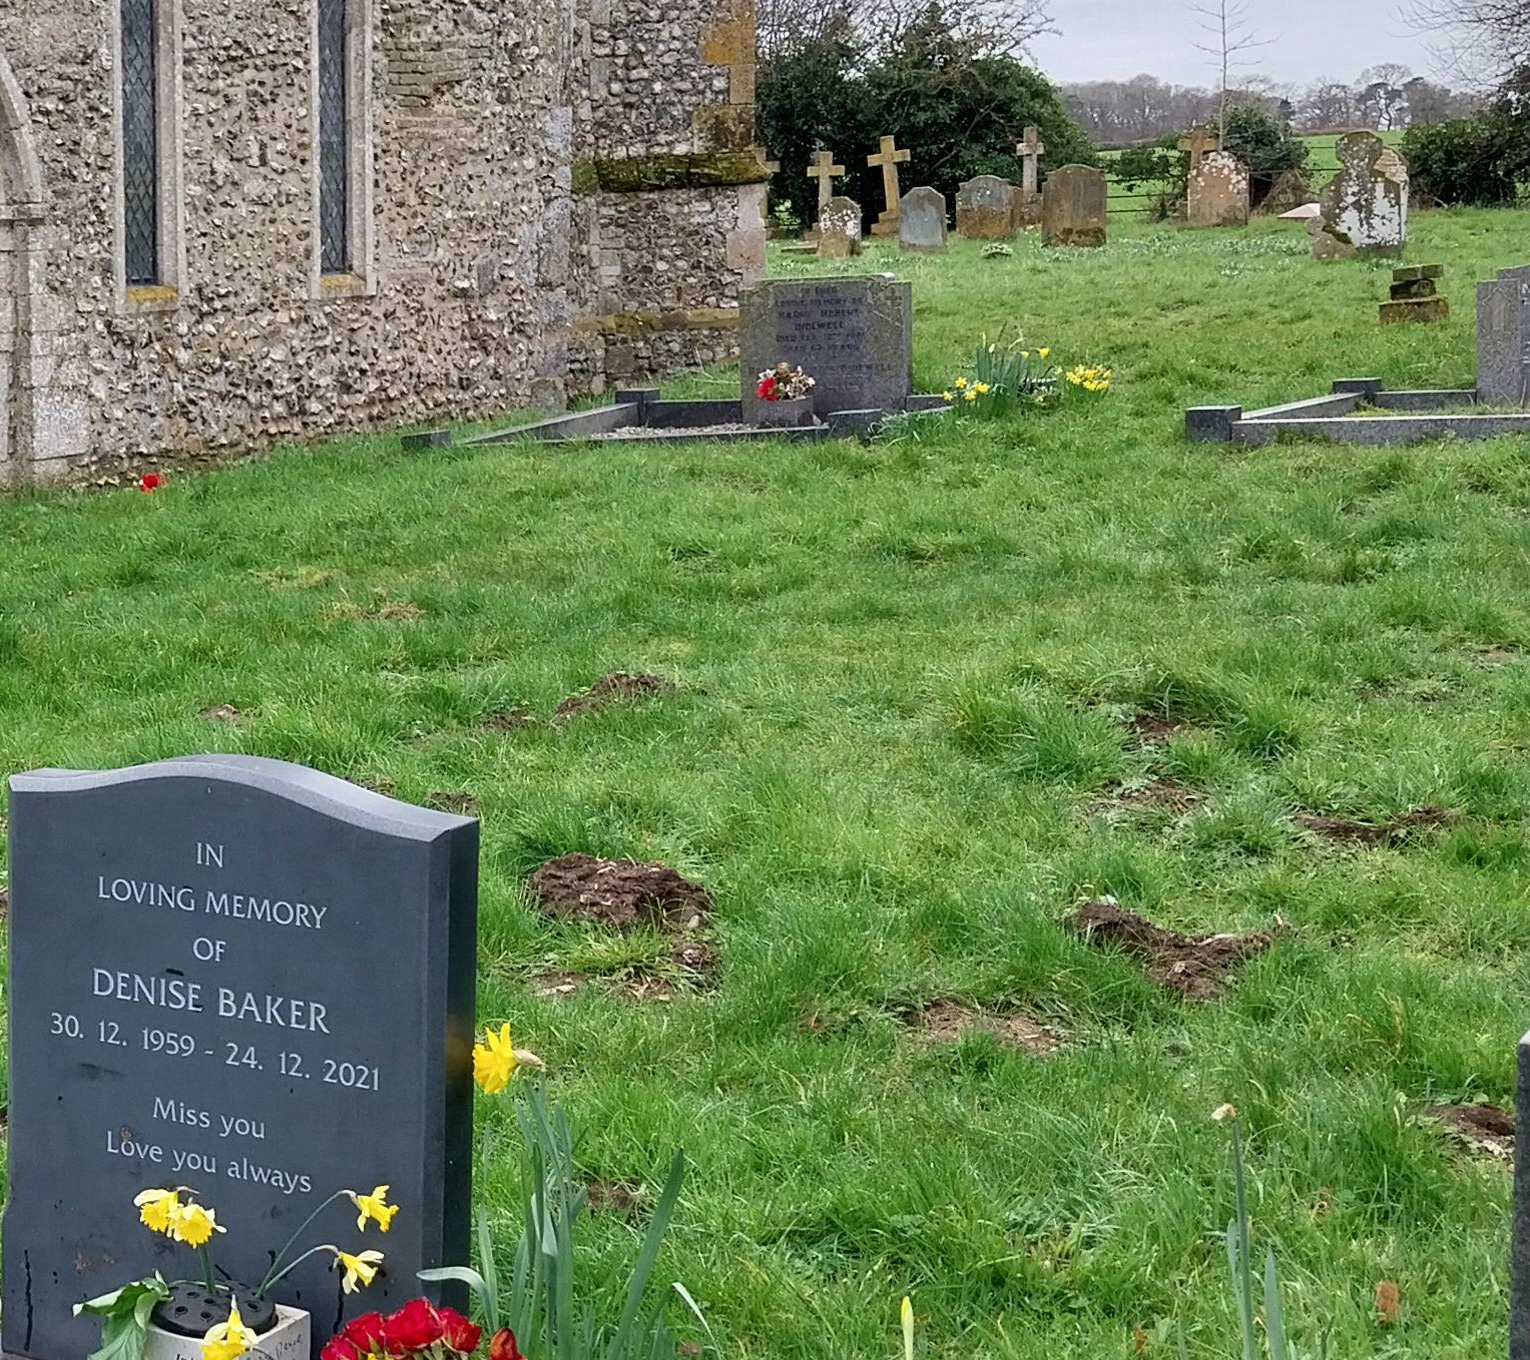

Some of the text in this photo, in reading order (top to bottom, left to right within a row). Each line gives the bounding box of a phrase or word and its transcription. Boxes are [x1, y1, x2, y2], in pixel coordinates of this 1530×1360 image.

[196, 843, 224, 868] IN
[98, 876, 328, 929] LOVING MEMORY
[192, 937, 227, 962] OF
[93, 968, 330, 1035] DENISE BAKER
[50, 1013, 84, 1039] 30.
[99, 1021, 128, 1047] 12.
[142, 1027, 195, 1057] 1959
[225, 1043, 264, 1070] 24.
[279, 1053, 310, 1079] 12.
[323, 1061, 381, 1091] 2021
[153, 1097, 267, 1139] Miss you
[106, 1130, 313, 1194] Love you always
